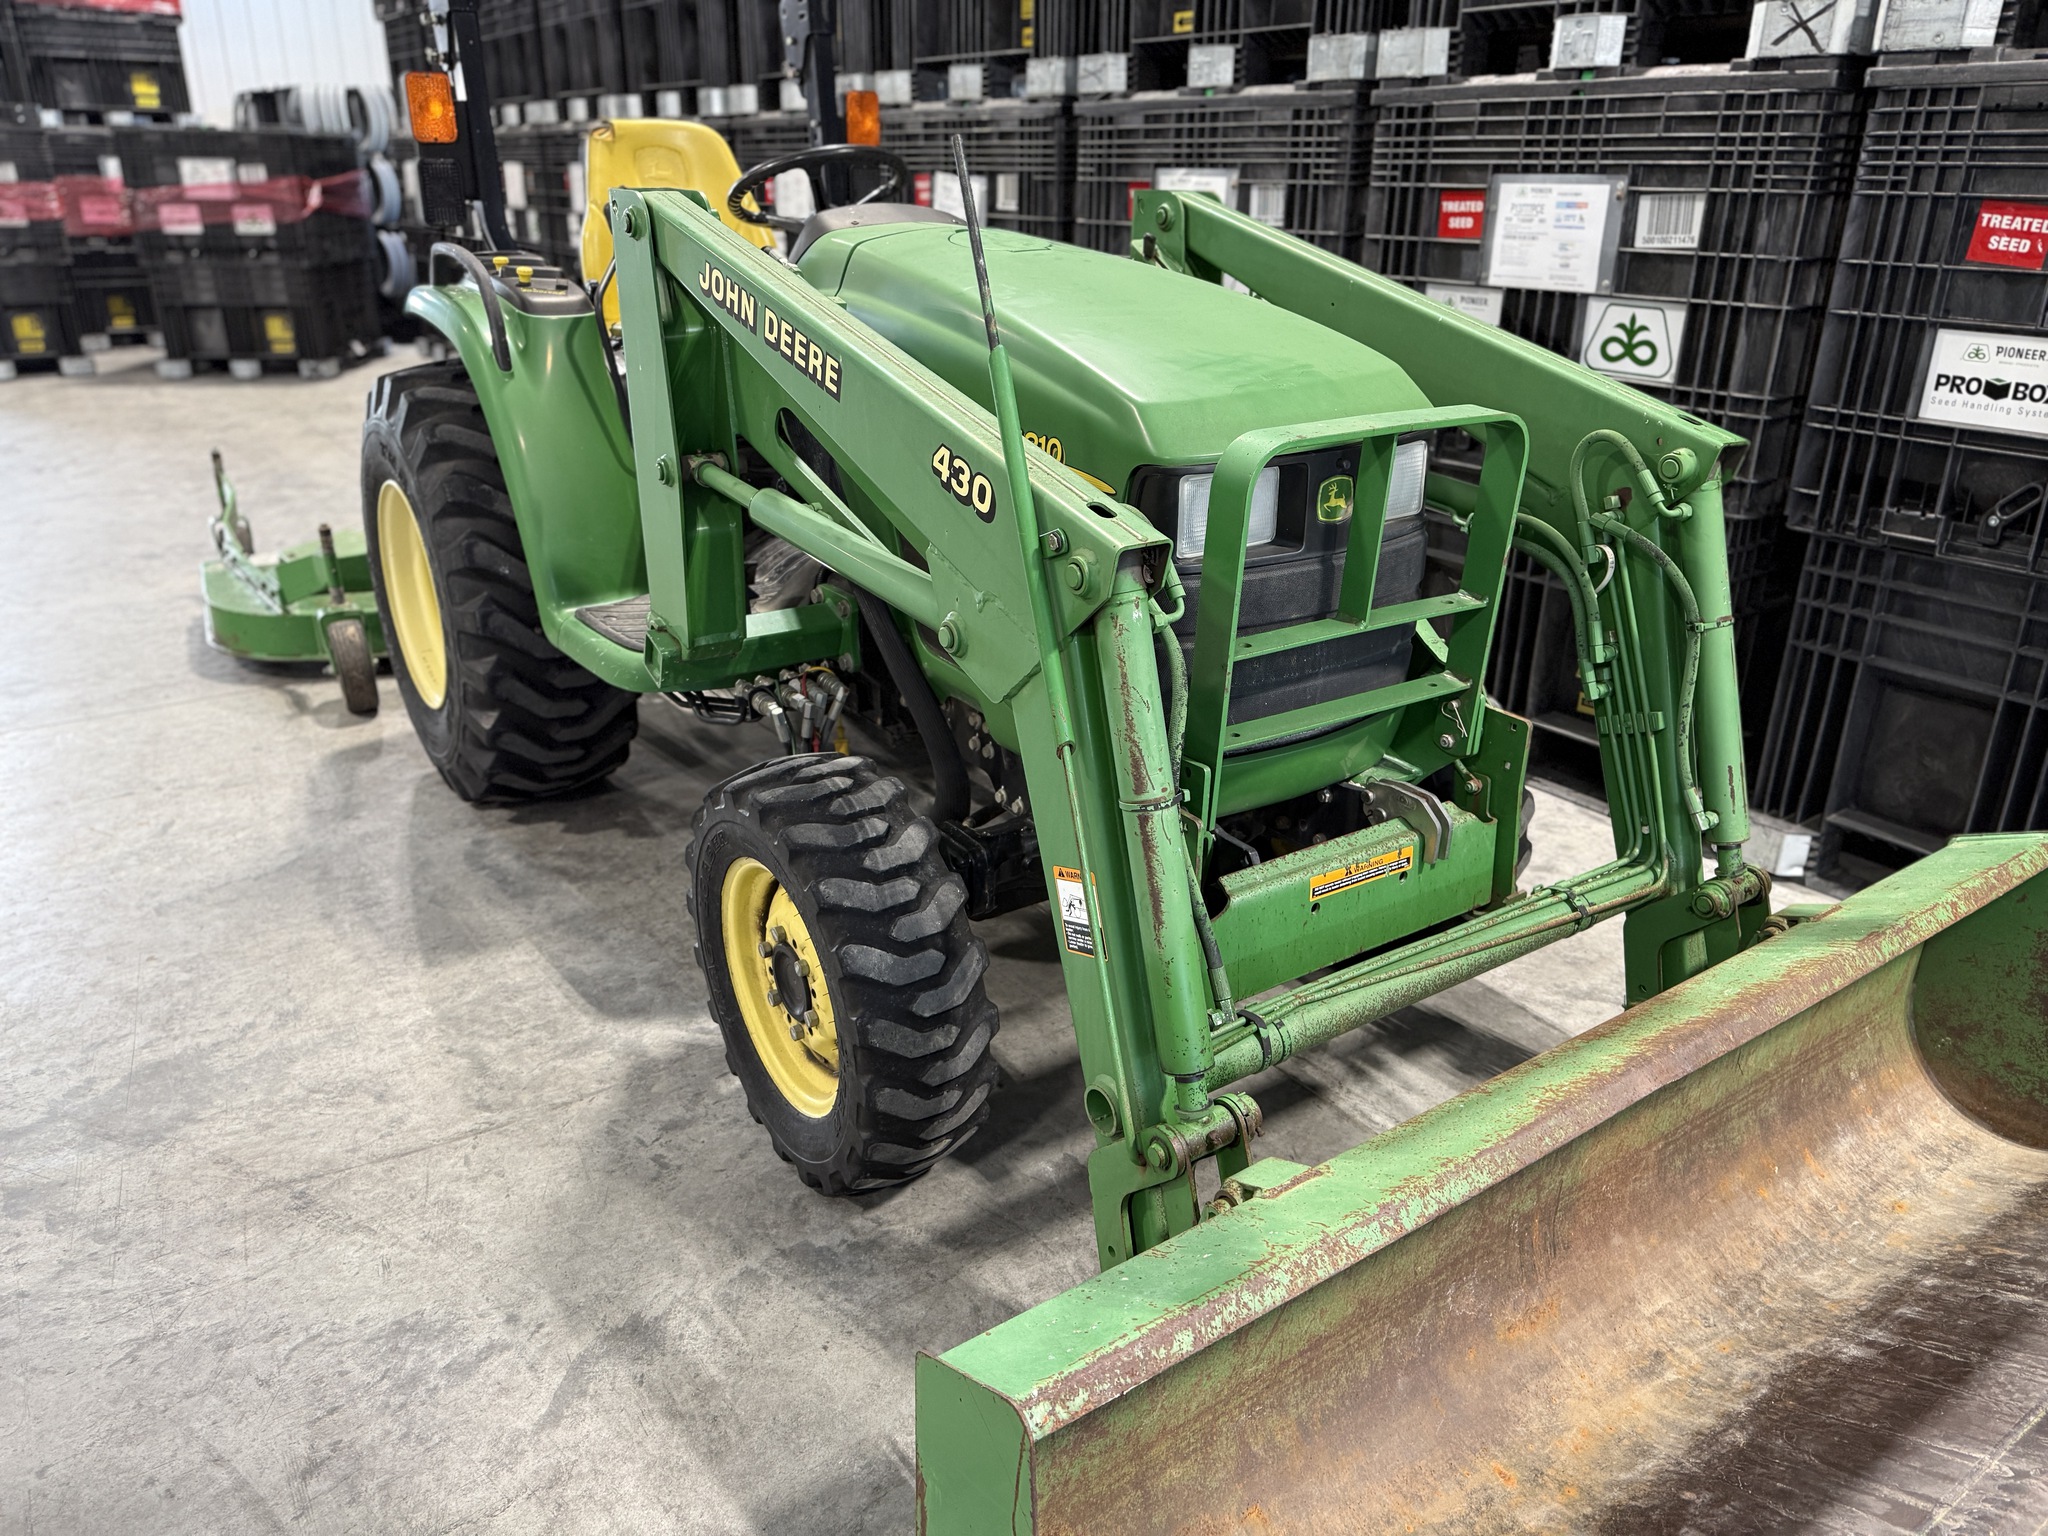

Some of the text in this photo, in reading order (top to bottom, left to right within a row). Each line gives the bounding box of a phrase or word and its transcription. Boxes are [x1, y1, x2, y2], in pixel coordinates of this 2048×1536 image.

[1441, 200, 1484, 213] TREATED
[1448, 216, 1474, 229] SEED
[1987, 235, 2031, 253] SEED
[698, 260, 843, 402] JOHN DEERE
[1996, 346, 2047, 362] PIONEER
[1930, 396, 2048, 419] Seed Handling Syste
[931, 443, 997, 523] 430
[1065, 870, 1082, 880] WARN
